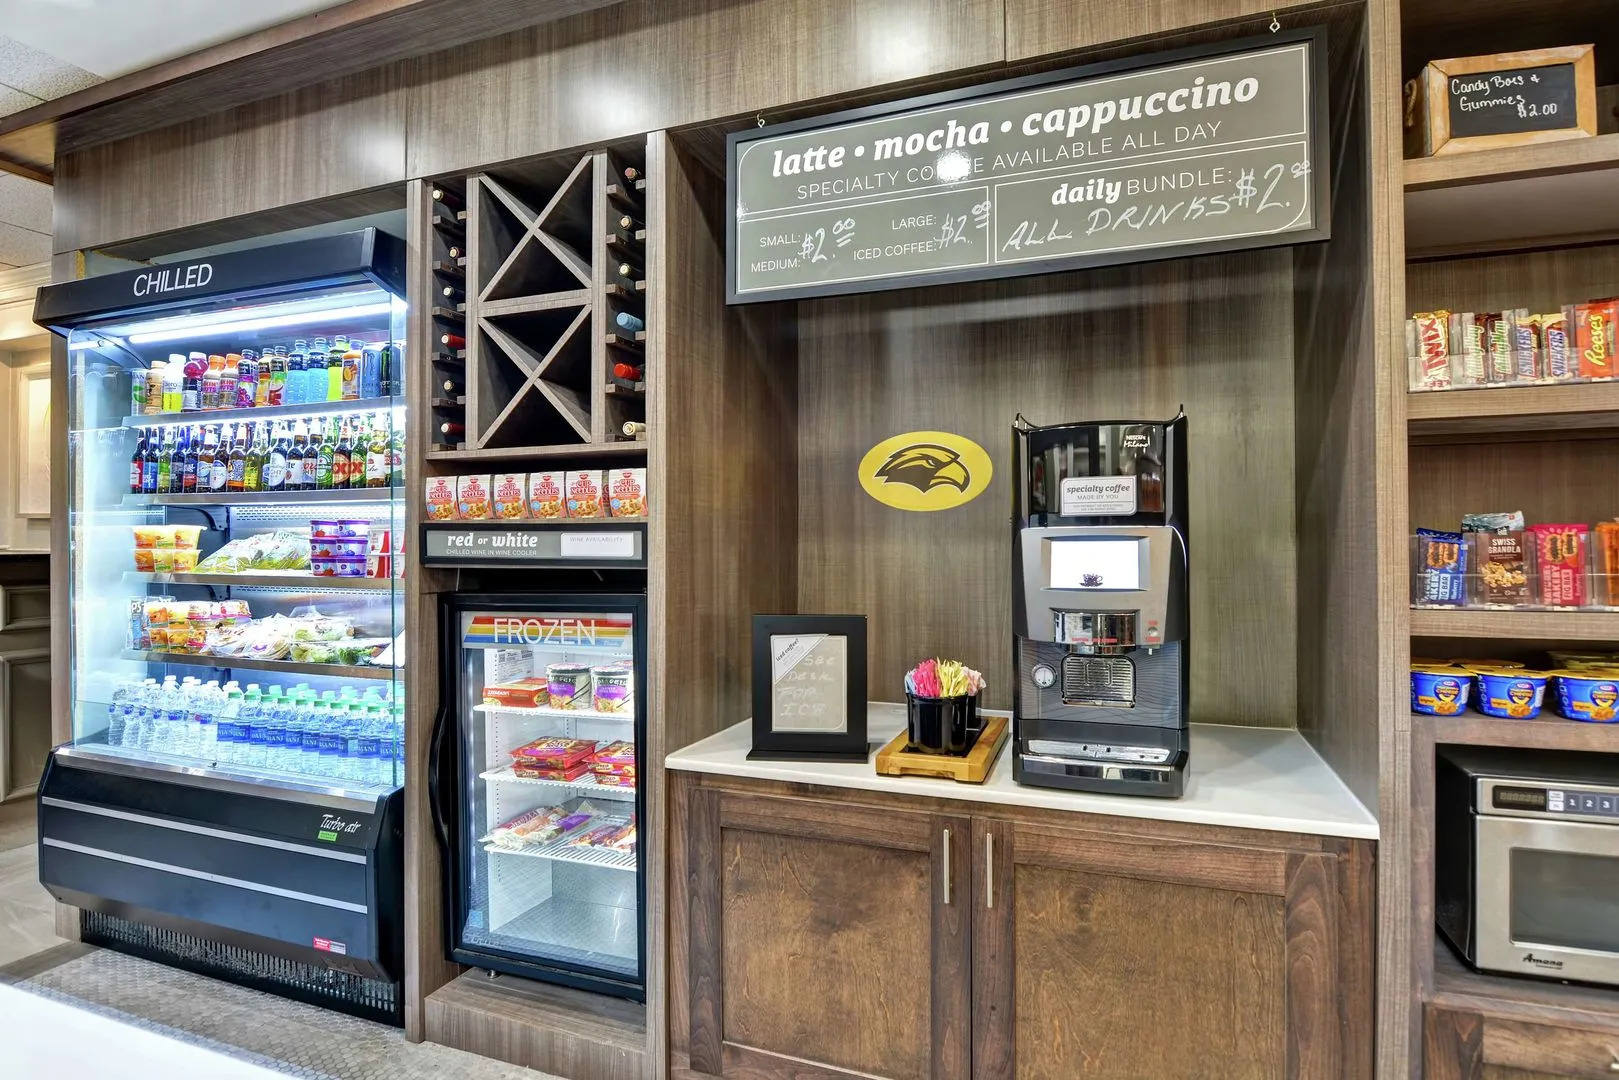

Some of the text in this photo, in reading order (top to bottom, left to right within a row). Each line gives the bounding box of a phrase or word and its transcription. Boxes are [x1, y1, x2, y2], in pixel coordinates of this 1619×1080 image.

[1451, 78, 1491, 96] Candy
[1460, 94, 1526, 112] Gummies
[1516, 103, 1558, 118] $2.00
[773, 76, 1259, 178] latte mocha cappuccino
[797, 120, 1222, 200] SPECIALTY COE AVAILABLE ALL DAY
[1051, 168, 1233, 206] daily BUNDLE:
[892, 214, 937, 231] LARGE:
[1002, 194, 1231, 252] ALL DRINKS
[760, 232, 801, 248] SMALL:
[853, 240, 937, 260] ICED COFFEE:
[751, 258, 801, 274] MEDIUM:
[134, 264, 213, 296] CHILLED
[1420, 318, 1448, 377] TWIX
[1516, 328, 1534, 376] SNICKERS
[1549, 330, 1566, 376] SNICKERS
[1067, 484, 1130, 494] specialty coffee
[447, 532, 474, 547] red
[492, 532, 538, 548] white
[1552, 564, 1561, 604] BAKERY
[494, 618, 596, 645] FROZEN
[1586, 799, 1594, 807] 2
[320, 813, 362, 833] Turbo air
